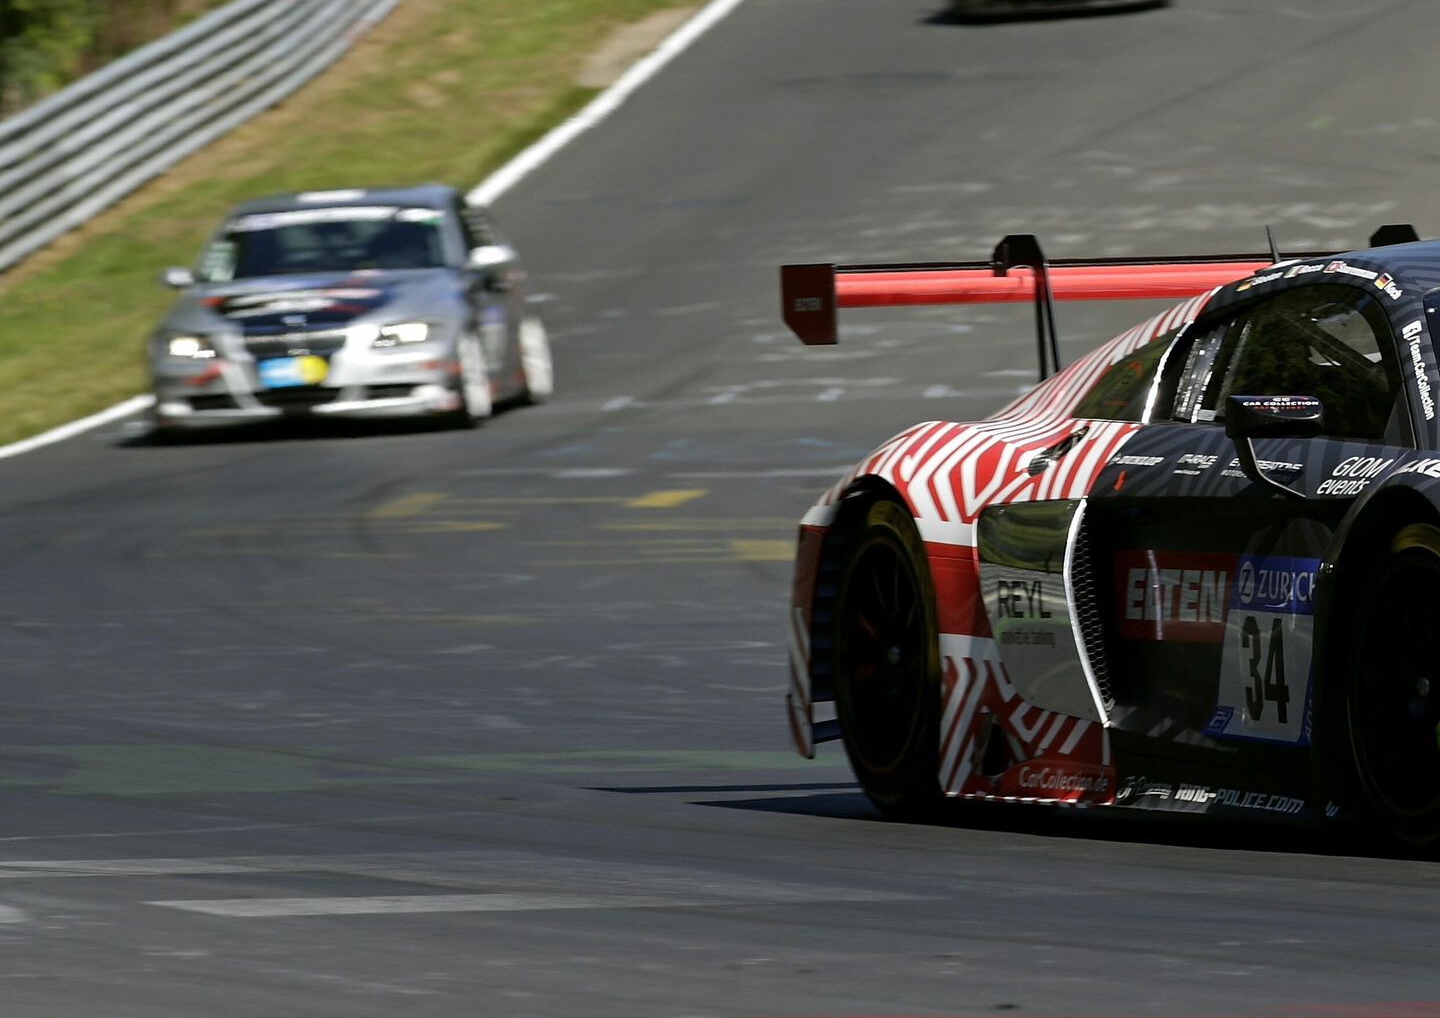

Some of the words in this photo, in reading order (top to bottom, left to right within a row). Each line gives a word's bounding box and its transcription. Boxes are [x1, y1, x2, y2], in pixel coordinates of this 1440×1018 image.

[1332, 456, 1393, 478] GIOM
[1316, 477, 1370, 495] events
[997, 580, 1052, 619] REYL
[1125, 567, 1228, 623] ELTEN
[1241, 615, 1290, 724] 34
[1019, 766, 1109, 794] CarCollection.de
